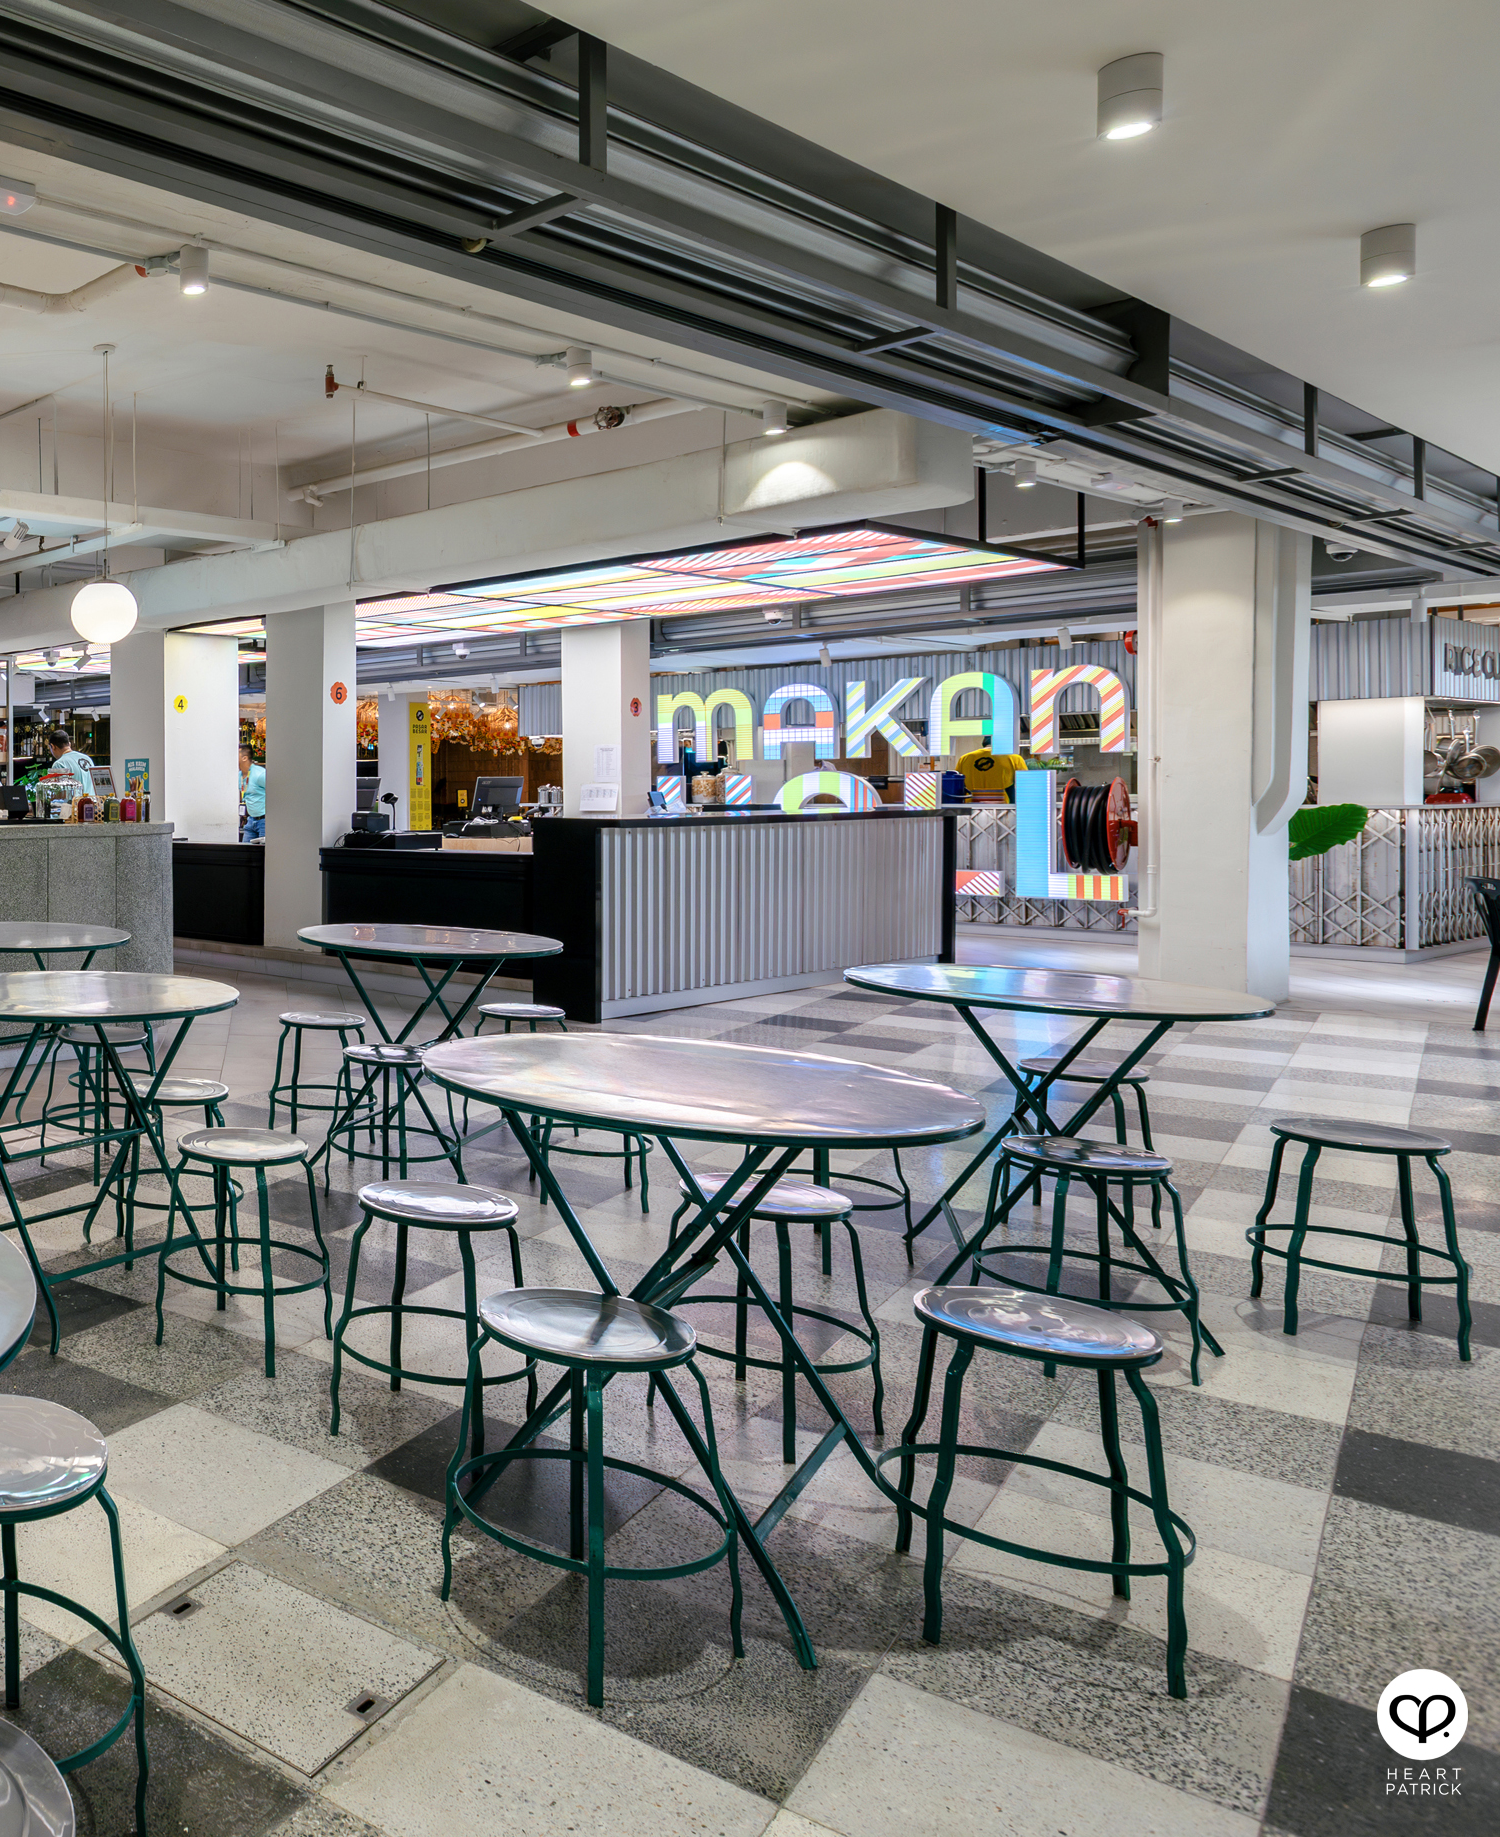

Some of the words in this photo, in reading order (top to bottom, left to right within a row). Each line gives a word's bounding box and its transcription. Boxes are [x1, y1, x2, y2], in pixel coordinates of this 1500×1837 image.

[335, 687, 343, 701] 6
[177, 699, 185, 711] 4
[633, 701, 639, 714] 3
